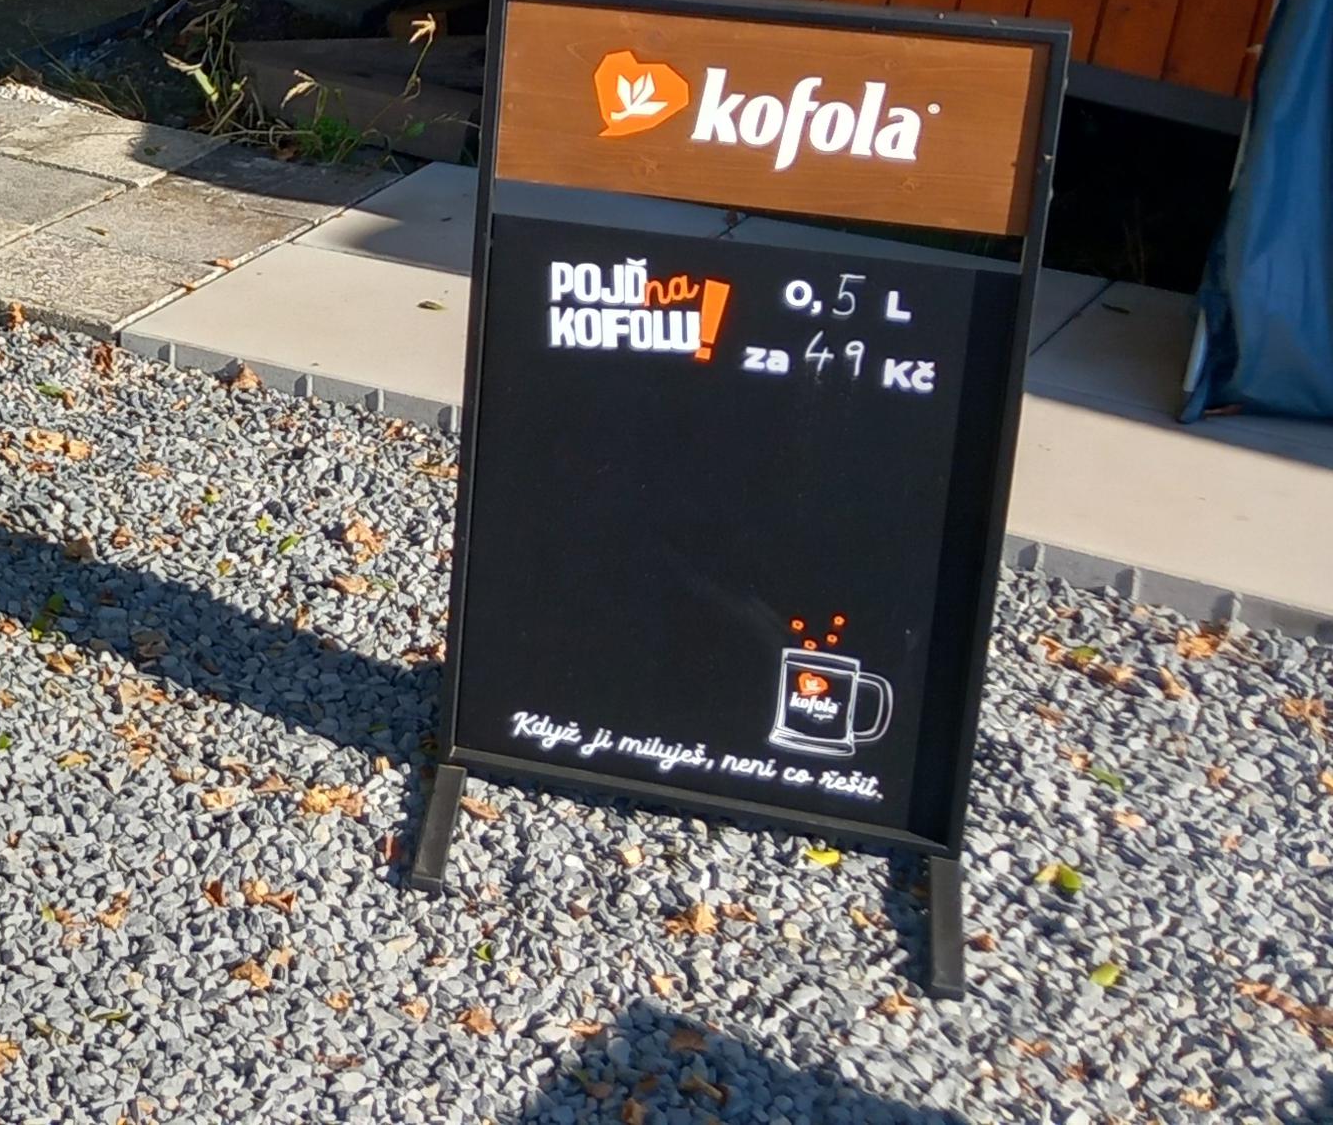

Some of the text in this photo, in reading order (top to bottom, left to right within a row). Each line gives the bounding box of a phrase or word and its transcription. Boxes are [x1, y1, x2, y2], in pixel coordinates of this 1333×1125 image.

[690, 66, 924, 171] kofola
[550, 257, 700, 307] POJĎ na
[886, 290, 912, 321] L
[549, 279, 730, 360] KOFOLU!
[743, 330, 935, 393] za 49 Kč
[789, 691, 839, 714] kofola
[513, 711, 582, 750] Když
[580, 727, 614, 755] ji
[617, 736, 714, 771] miluješ,
[782, 766, 815, 784] co
[819, 770, 884, 802] řešit.
